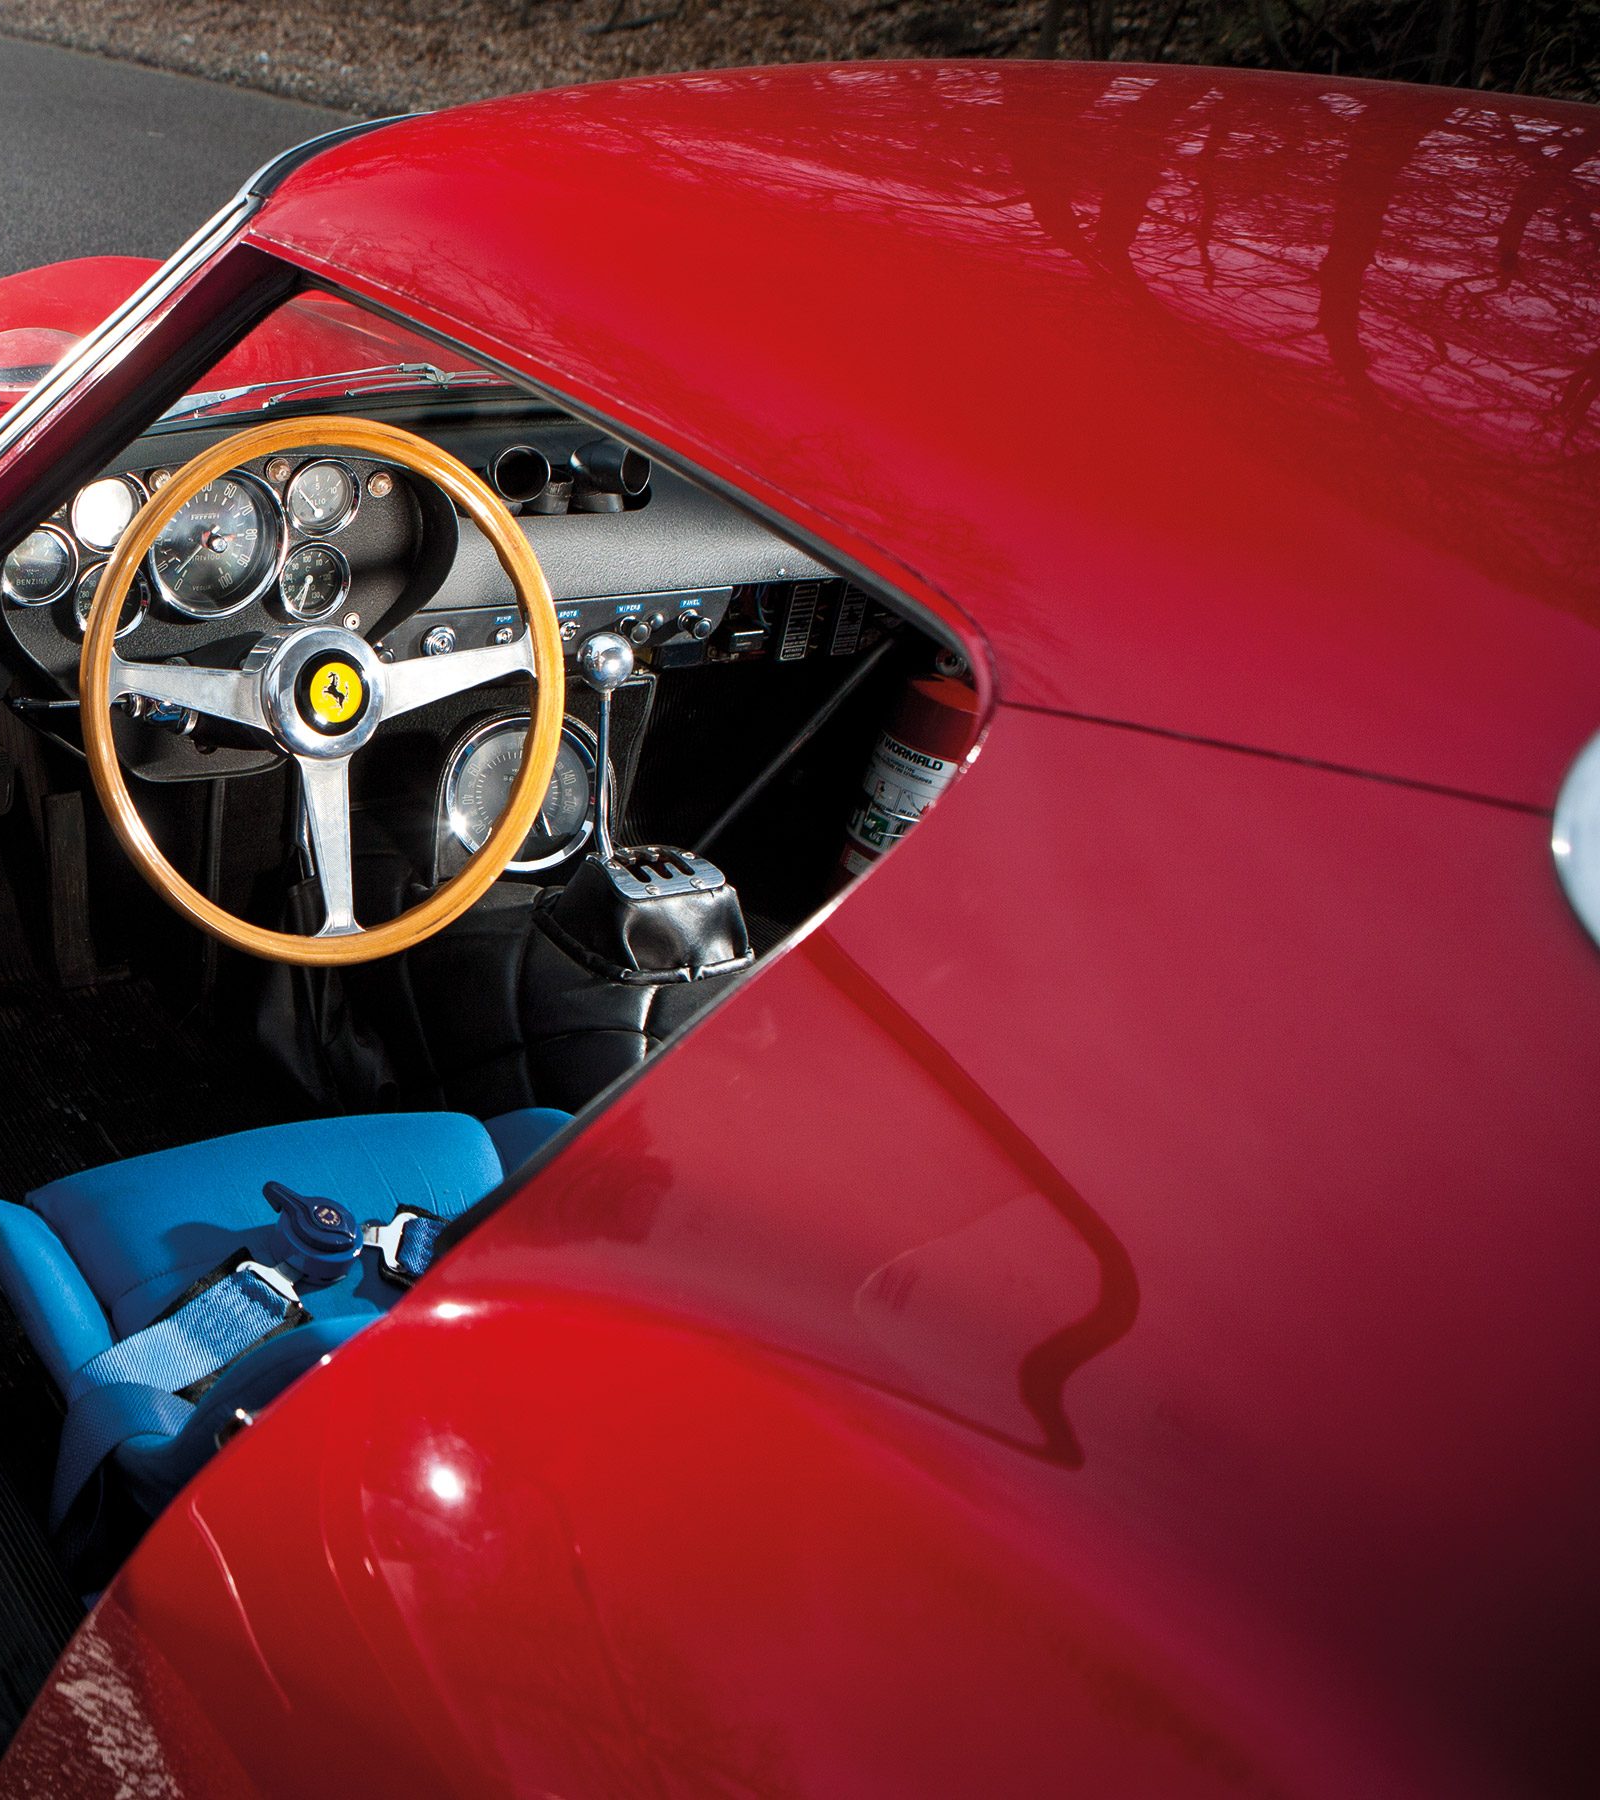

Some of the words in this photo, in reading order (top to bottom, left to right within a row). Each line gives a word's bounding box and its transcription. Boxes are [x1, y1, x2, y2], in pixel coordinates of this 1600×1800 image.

[224, 483, 238, 499] 60
[315, 482, 321, 491] 5
[330, 486, 338, 495] 10
[240, 500, 254, 516] 70
[245, 528, 258, 541] 80
[237, 553, 251, 568] 90
[302, 554, 312, 563] 100
[315, 558, 323, 566] 110
[291, 562, 300, 571] 90
[16, 578, 49, 586] BENZINA
[174, 578, 183, 591] 0
[218, 572, 234, 590] 100
[618, 604, 641, 612] WIPERS
[682, 599, 700, 607] PANEL
[558, 610, 578, 618] SPOTS
[883, 735, 944, 772] WORMALD
[467, 763, 481, 777] 60
[561, 769, 577, 786] 140
[462, 794, 475, 805] 40
[471, 819, 486, 835] 20
